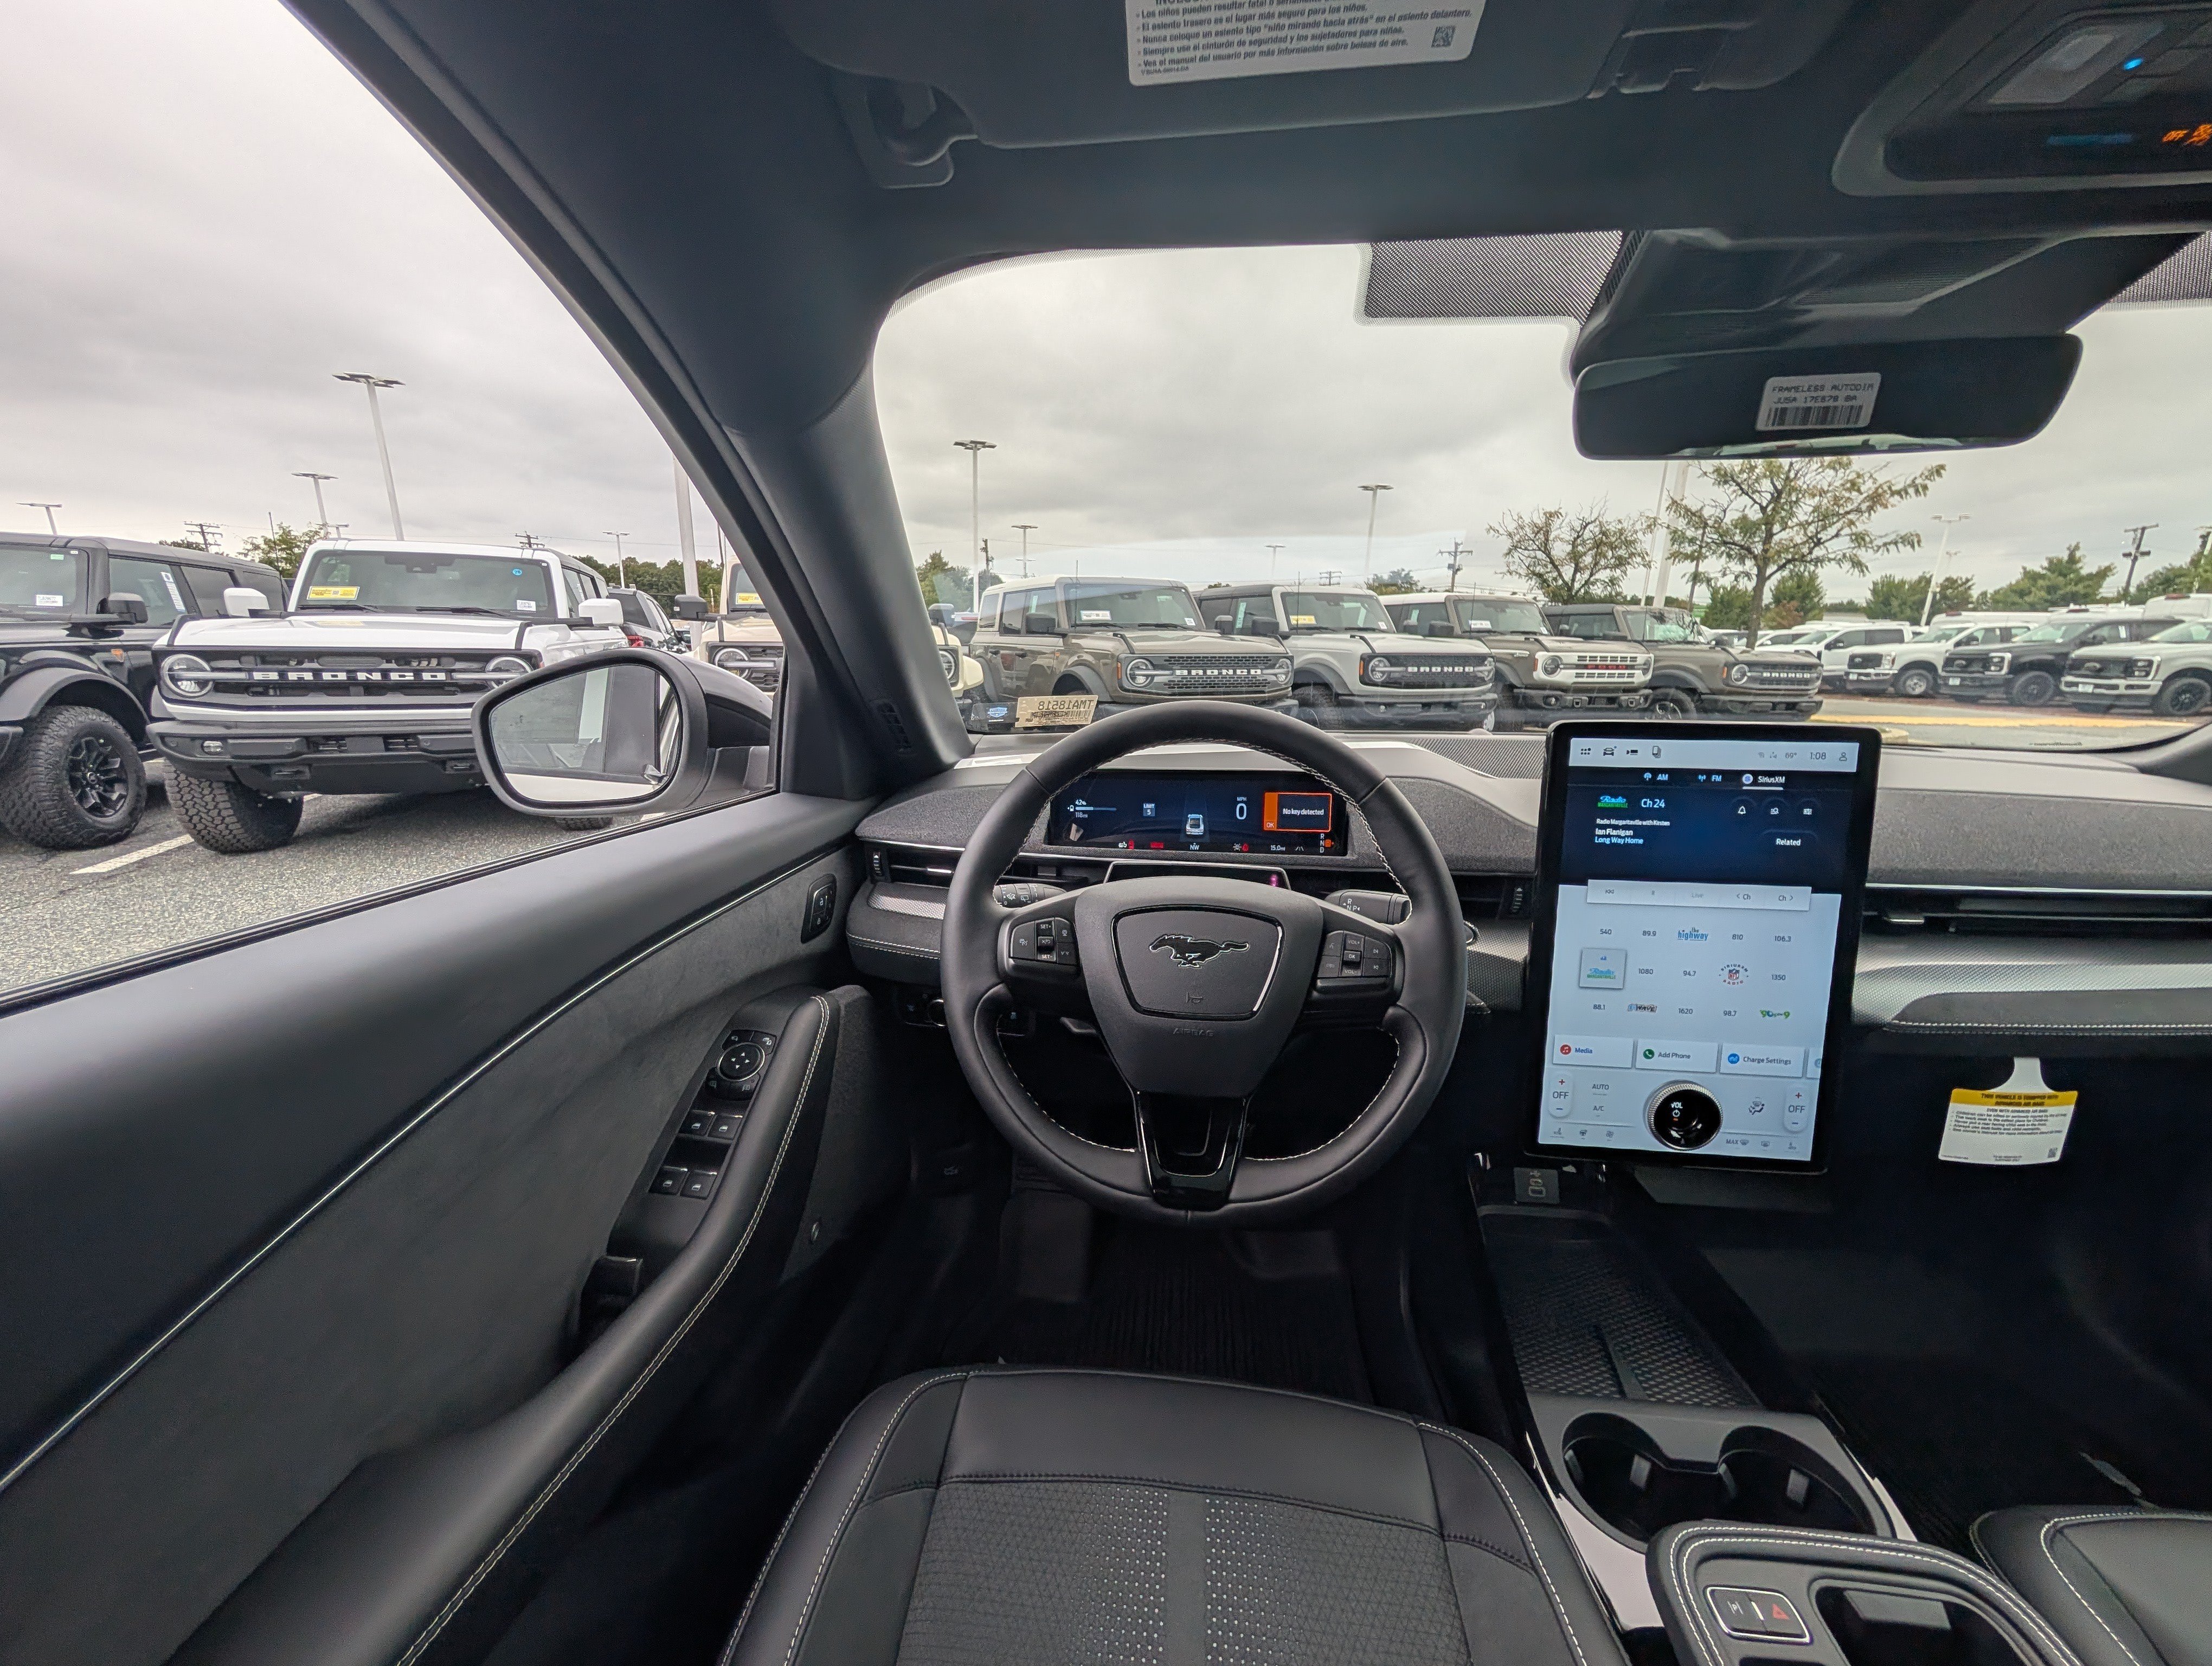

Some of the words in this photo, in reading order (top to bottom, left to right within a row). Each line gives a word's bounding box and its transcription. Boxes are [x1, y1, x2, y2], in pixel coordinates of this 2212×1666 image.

[1182, 3, 1212, 17] pueden
[1235, 13, 1256, 24] lugar
[1308, 7, 1327, 18] para
[1246, 24, 1262, 37] tipo
[1288, 19, 1321, 30] mirando
[1323, 16, 1346, 28] hacia
[1359, 28, 1378, 39] para
[1168, 55, 1197, 65] manual
[1326, 42, 1348, 53] sobre
[1772, 384, 1826, 393] FRAMELESS
[253, 671, 446, 680] BRONCO
[1810, 752, 1827, 760] 1:08
[1758, 776, 1785, 784] SiriusXM
[1600, 795, 1626, 803] Radio
[1641, 798, 1652, 808] Ch
[1654, 799, 1665, 808] 24
[1236, 803, 1247, 820] 0
[1291, 808, 1301, 816] key
[1606, 828, 1634, 836] Flanigan
[1594, 836, 1610, 844] Long
[1776, 838, 1801, 846] Related
[1677, 930, 1709, 941] highway
[1743, 1056, 1765, 1065] Charge
[1552, 1091, 1570, 1099] OFF
[1788, 1105, 1805, 1113] OFF
